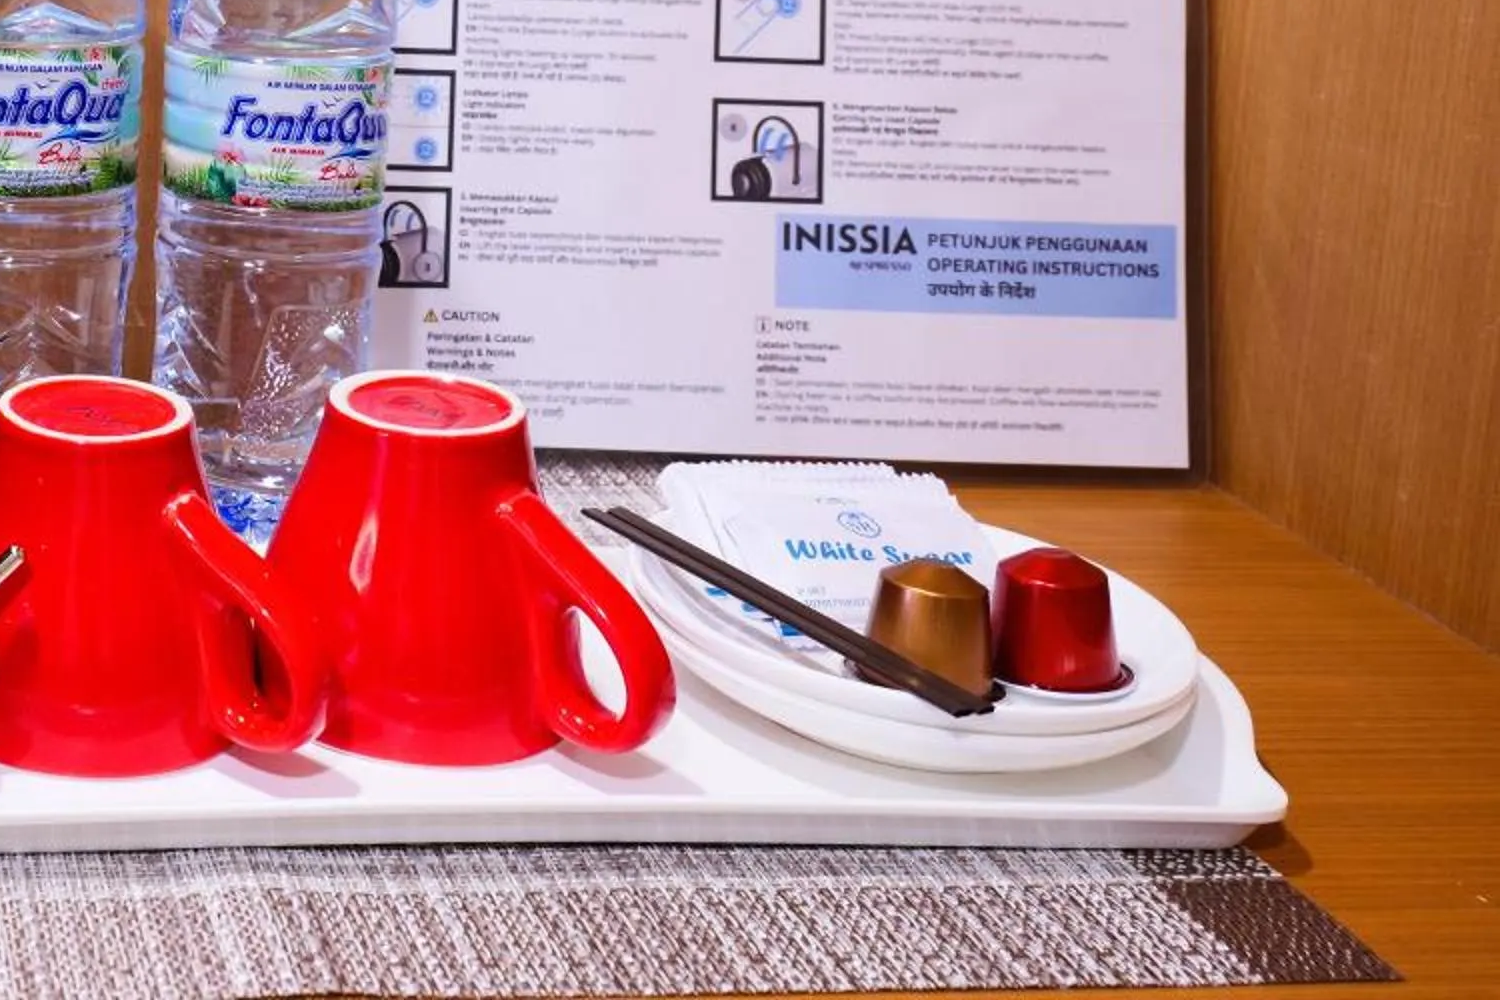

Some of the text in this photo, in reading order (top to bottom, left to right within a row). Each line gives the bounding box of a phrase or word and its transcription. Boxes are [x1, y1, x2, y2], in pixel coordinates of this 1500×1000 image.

[783, 221, 918, 255] INISSIA
[927, 233, 1148, 254] PETUNJUK PENGGUNAAN
[927, 257, 1160, 278] OPERATING INSTRUCTIONS
[927, 280, 975, 298] उपयोग
[979, 280, 995, 298] के
[441, 310, 500, 322] CAUTION
[775, 319, 809, 332] NOTE
[784, 538, 973, 565] White Sar
